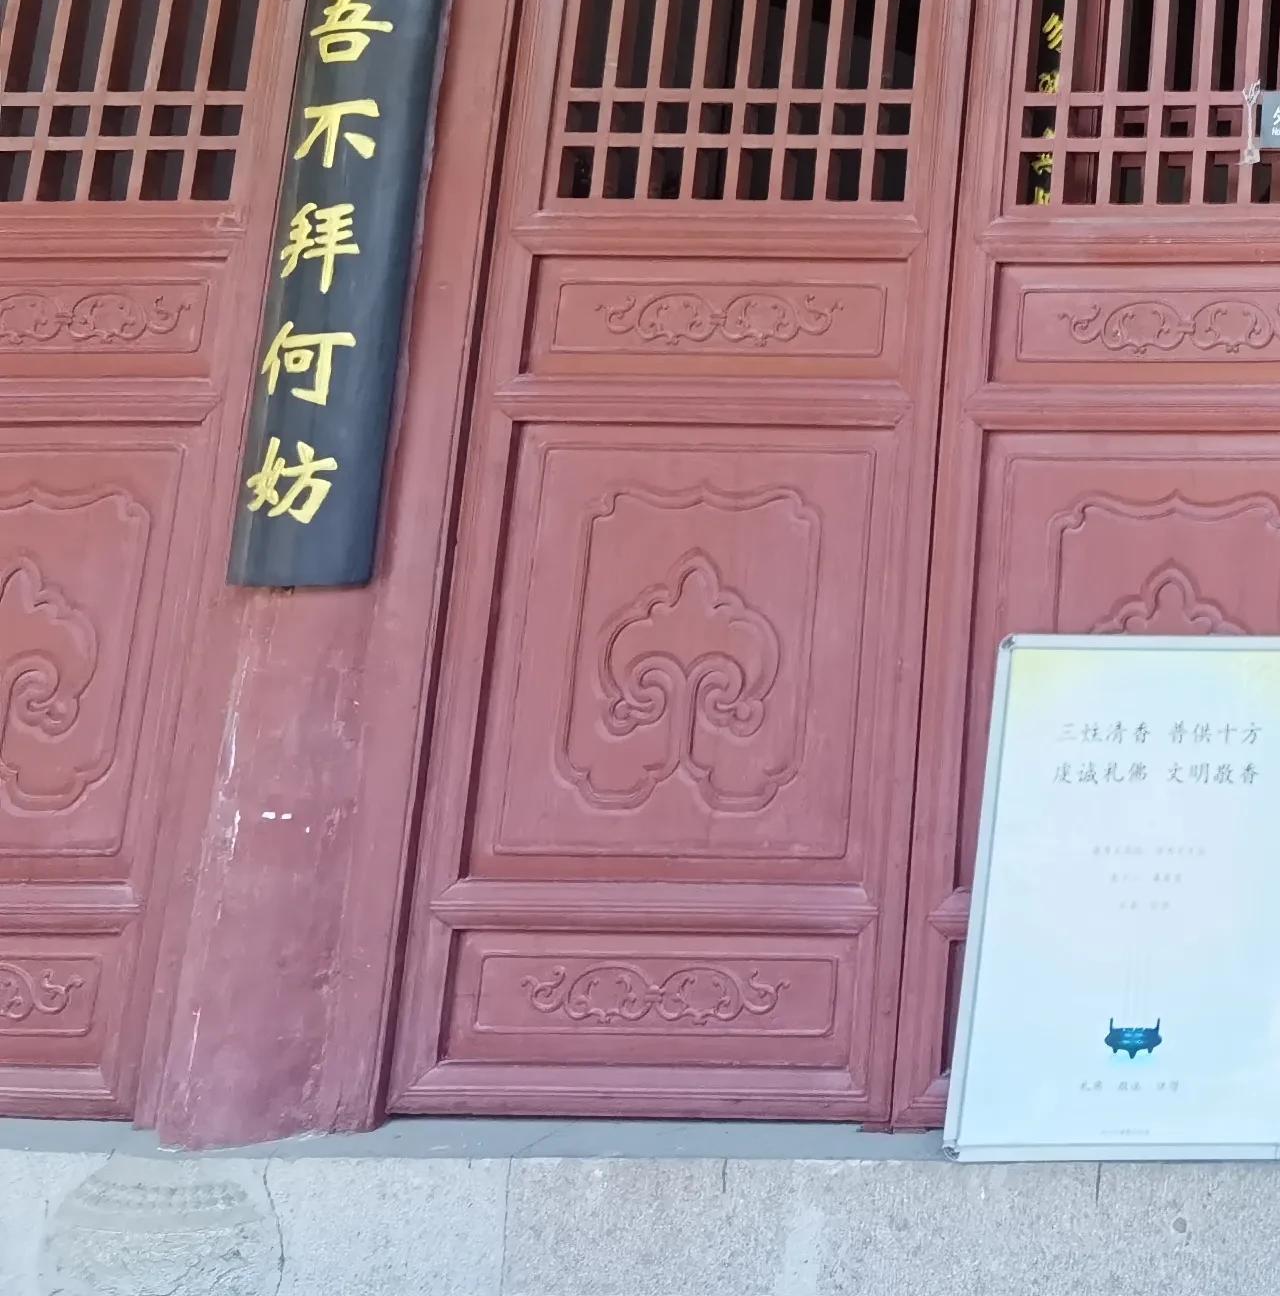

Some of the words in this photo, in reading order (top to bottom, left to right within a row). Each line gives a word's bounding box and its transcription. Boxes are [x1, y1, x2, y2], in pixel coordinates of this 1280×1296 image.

[1272, 126, 1280, 136] No
[1167, 761, 1258, 784] 文明敬香
